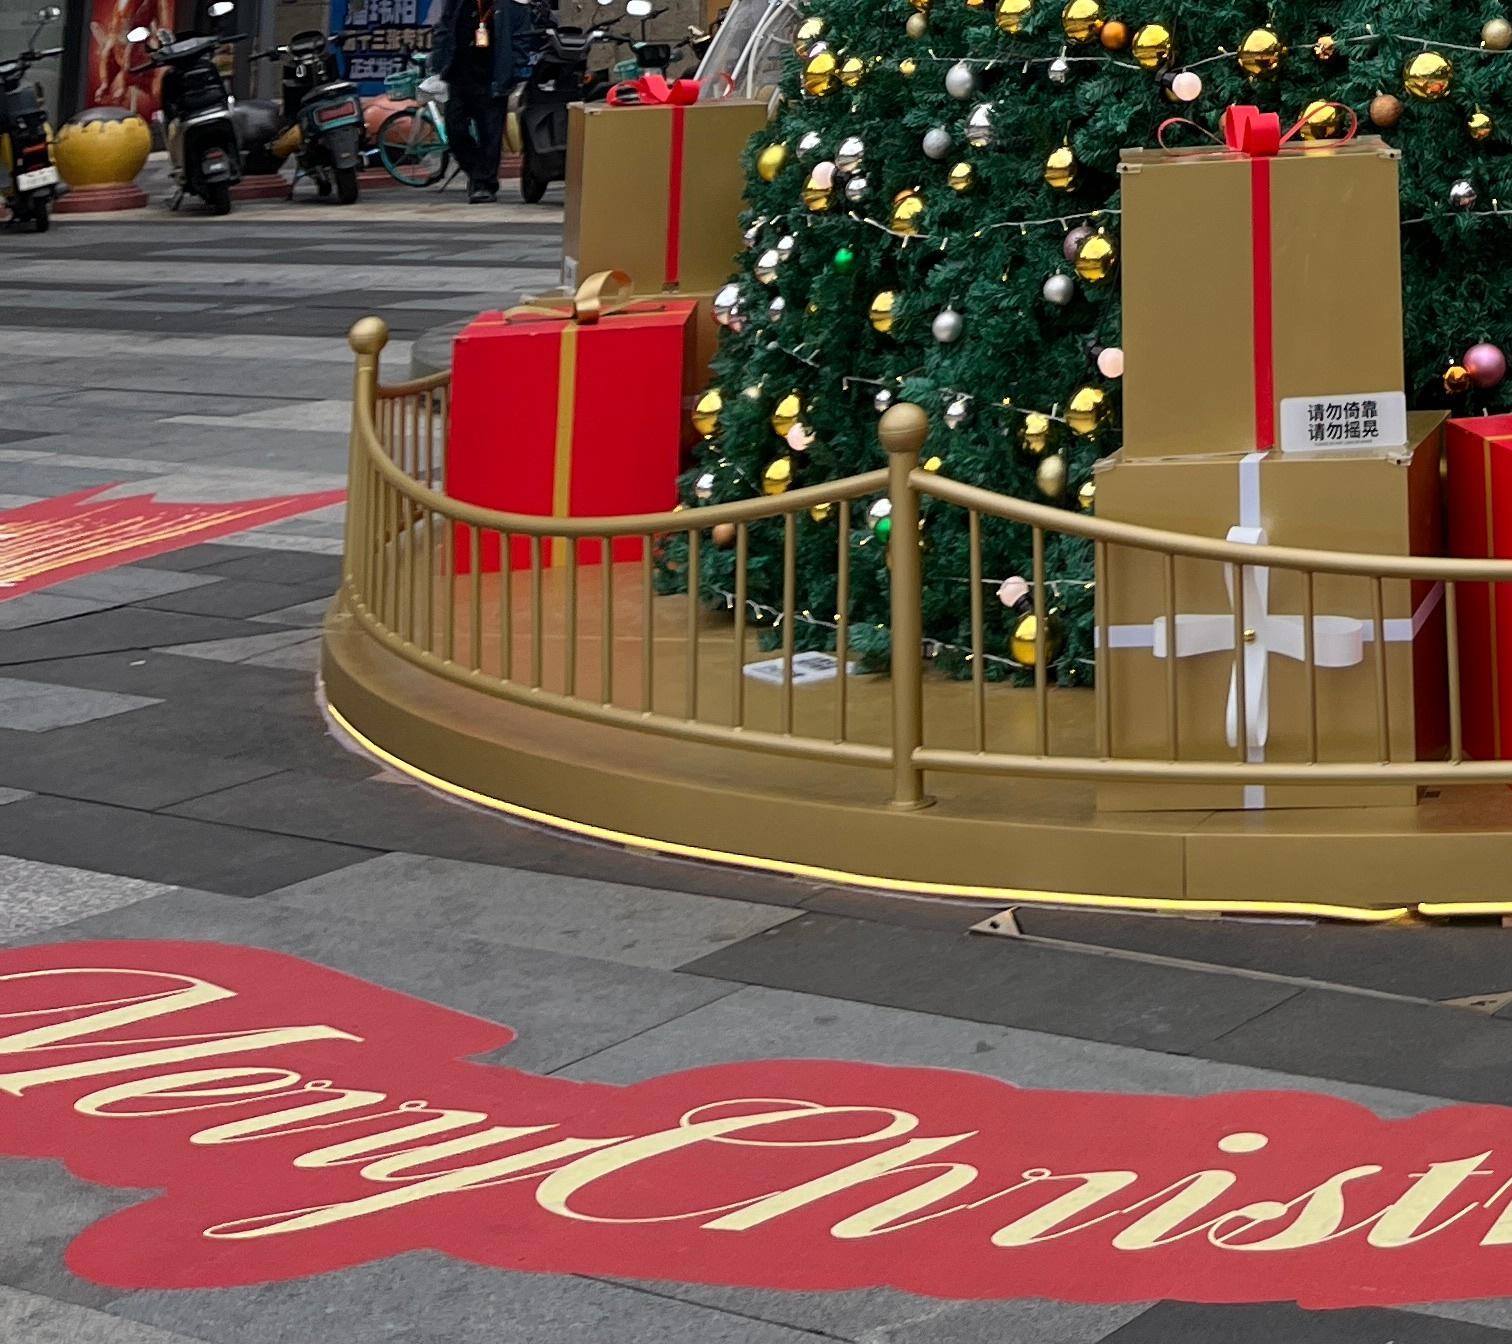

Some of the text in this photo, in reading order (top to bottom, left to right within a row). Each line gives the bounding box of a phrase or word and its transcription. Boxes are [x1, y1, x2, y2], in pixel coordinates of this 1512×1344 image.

[1308, 400, 1378, 422] 请勿倚靠
[1308, 419, 1380, 442] 请勿摇晃
[0, 967, 634, 1239] Merry
